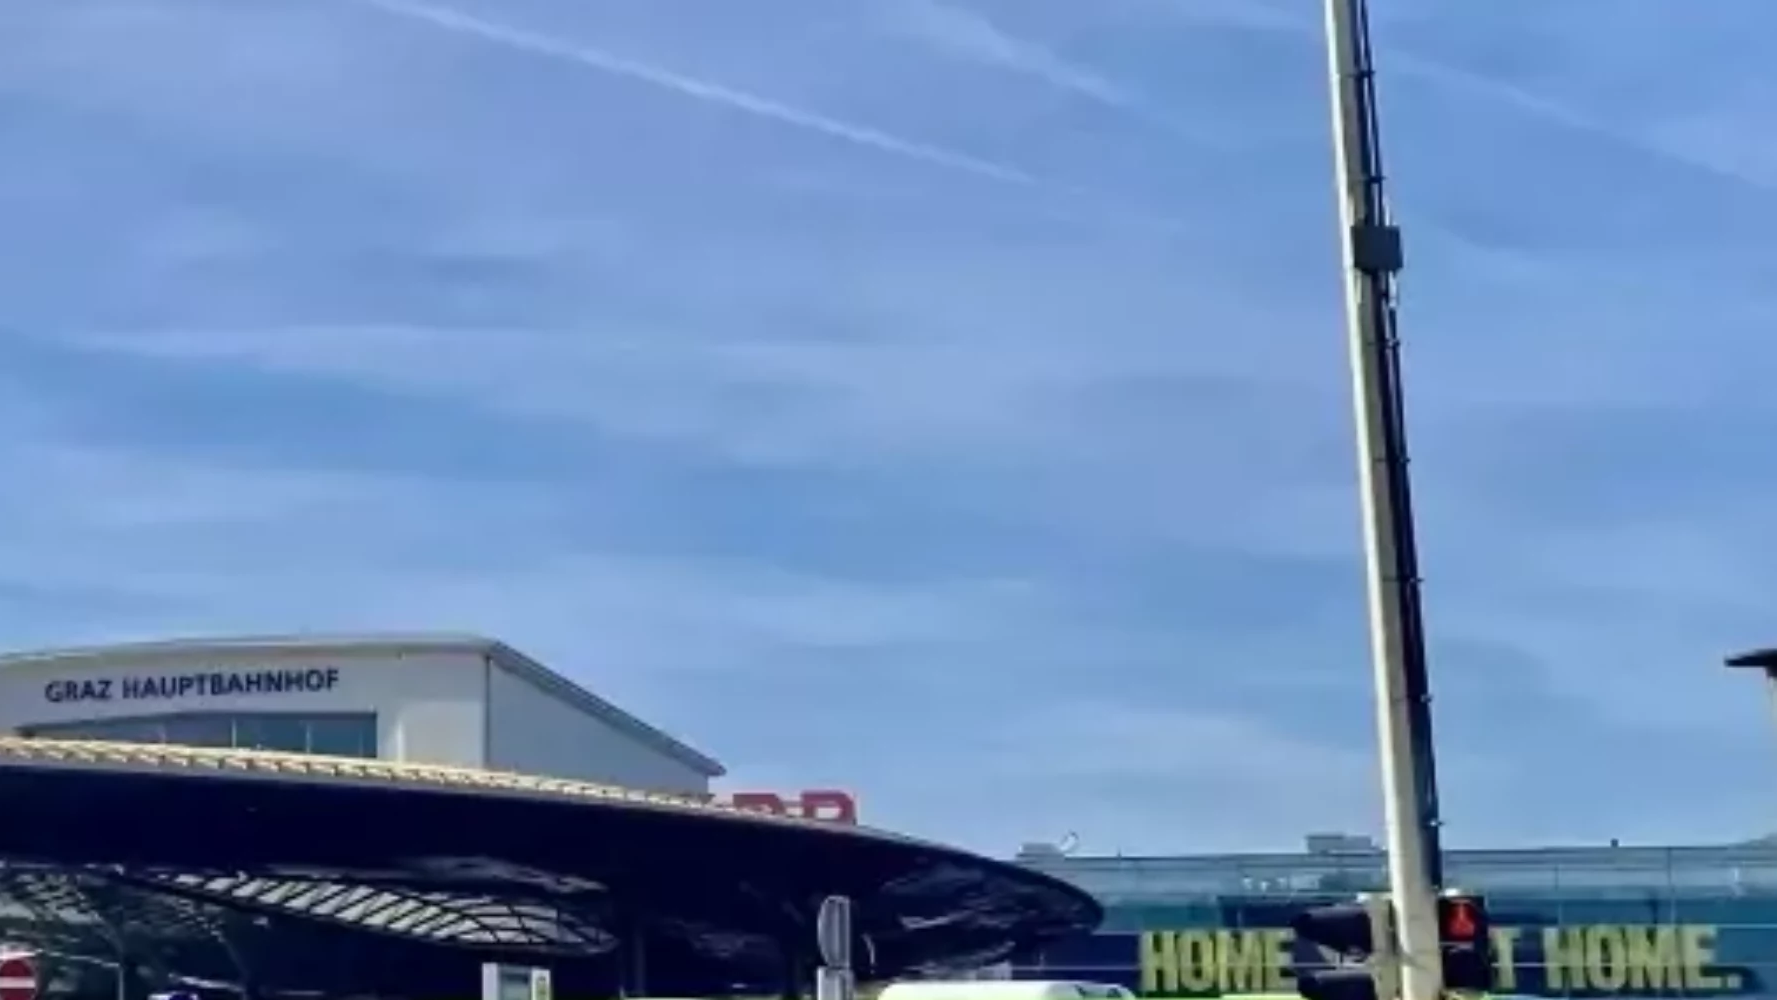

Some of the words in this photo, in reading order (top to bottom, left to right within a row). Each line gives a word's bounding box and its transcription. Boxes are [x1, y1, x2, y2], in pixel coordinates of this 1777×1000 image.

[44, 679, 113, 702] GRAZ
[122, 668, 340, 699] HAUPTBAHNHOF
[1140, 928, 1299, 992] HOME
[1542, 923, 1743, 989] HOME.
